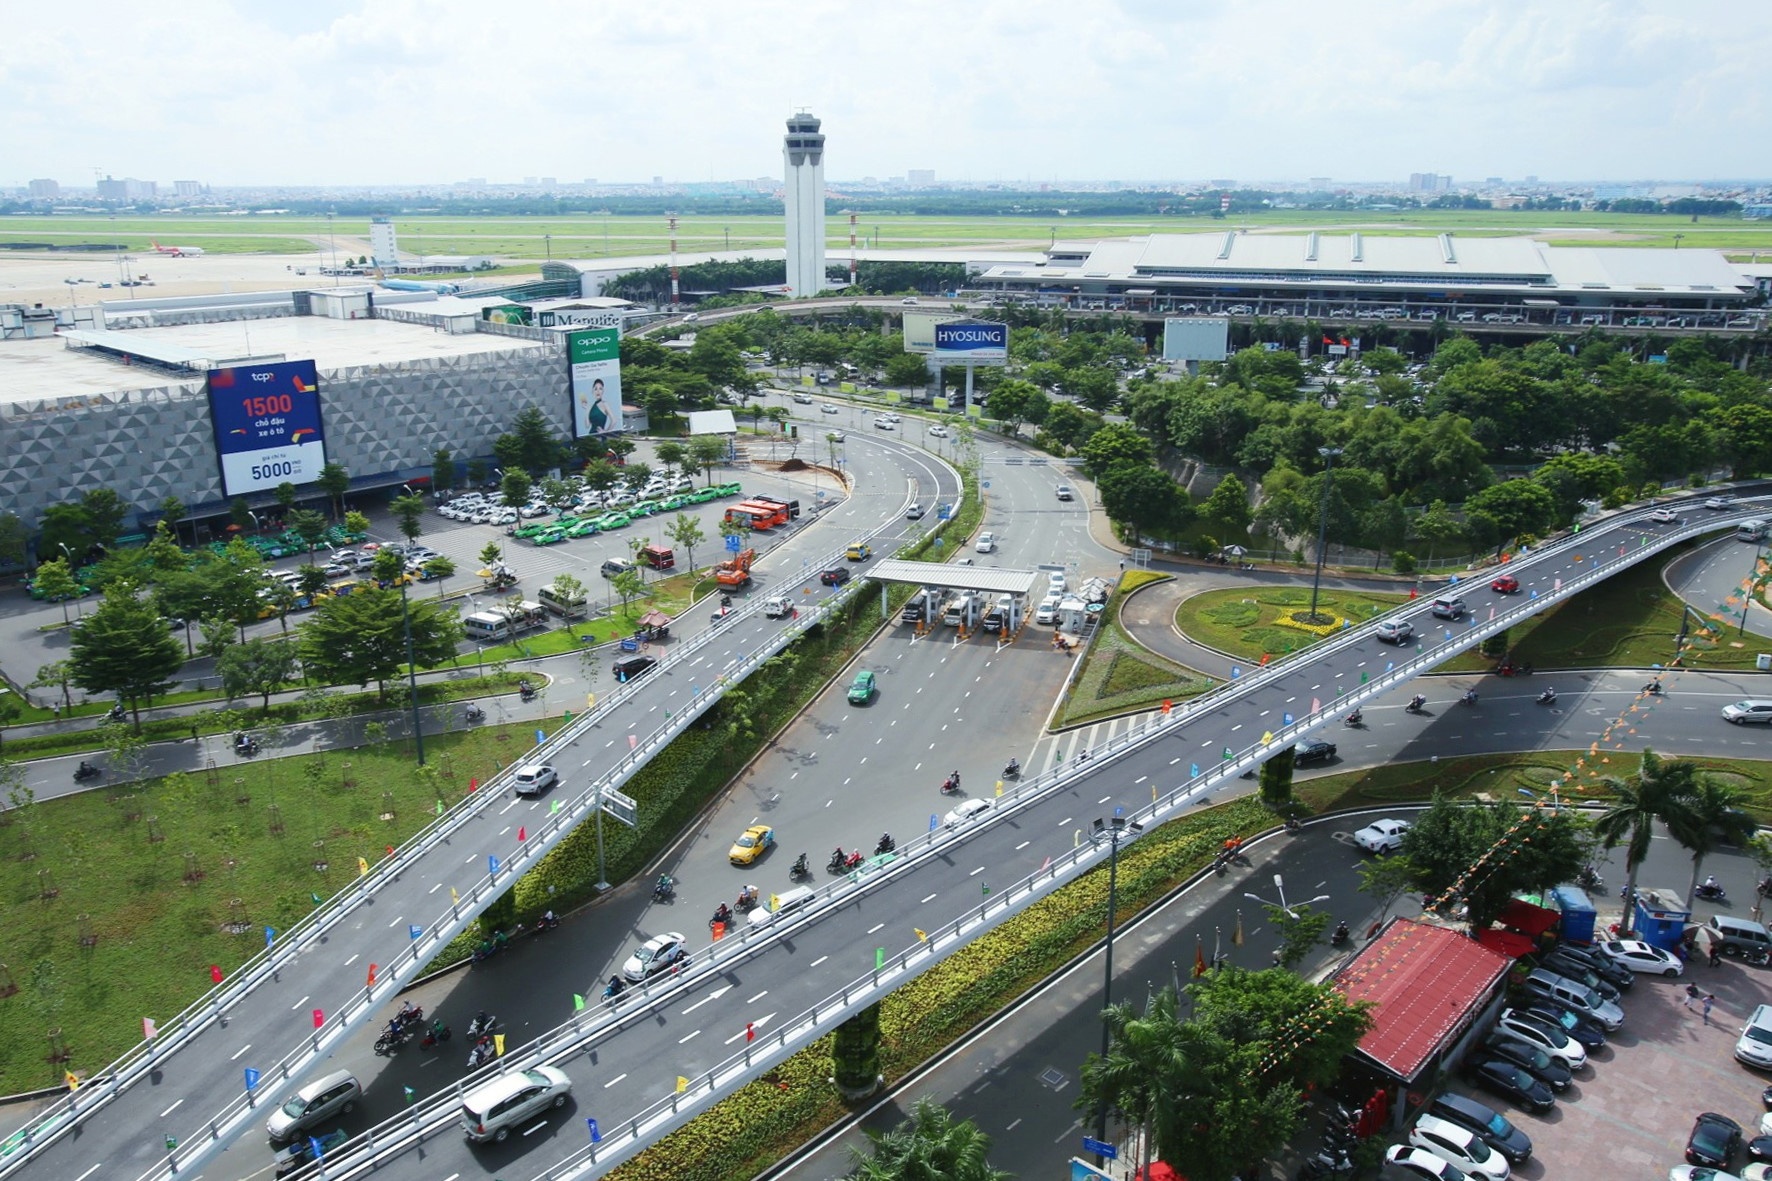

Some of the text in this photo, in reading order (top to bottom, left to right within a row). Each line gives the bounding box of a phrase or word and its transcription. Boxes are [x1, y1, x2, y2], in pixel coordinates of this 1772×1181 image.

[938, 331, 1000, 342] HYOSUNG
[243, 394, 292, 416] 1500
[252, 462, 292, 480] 5000
